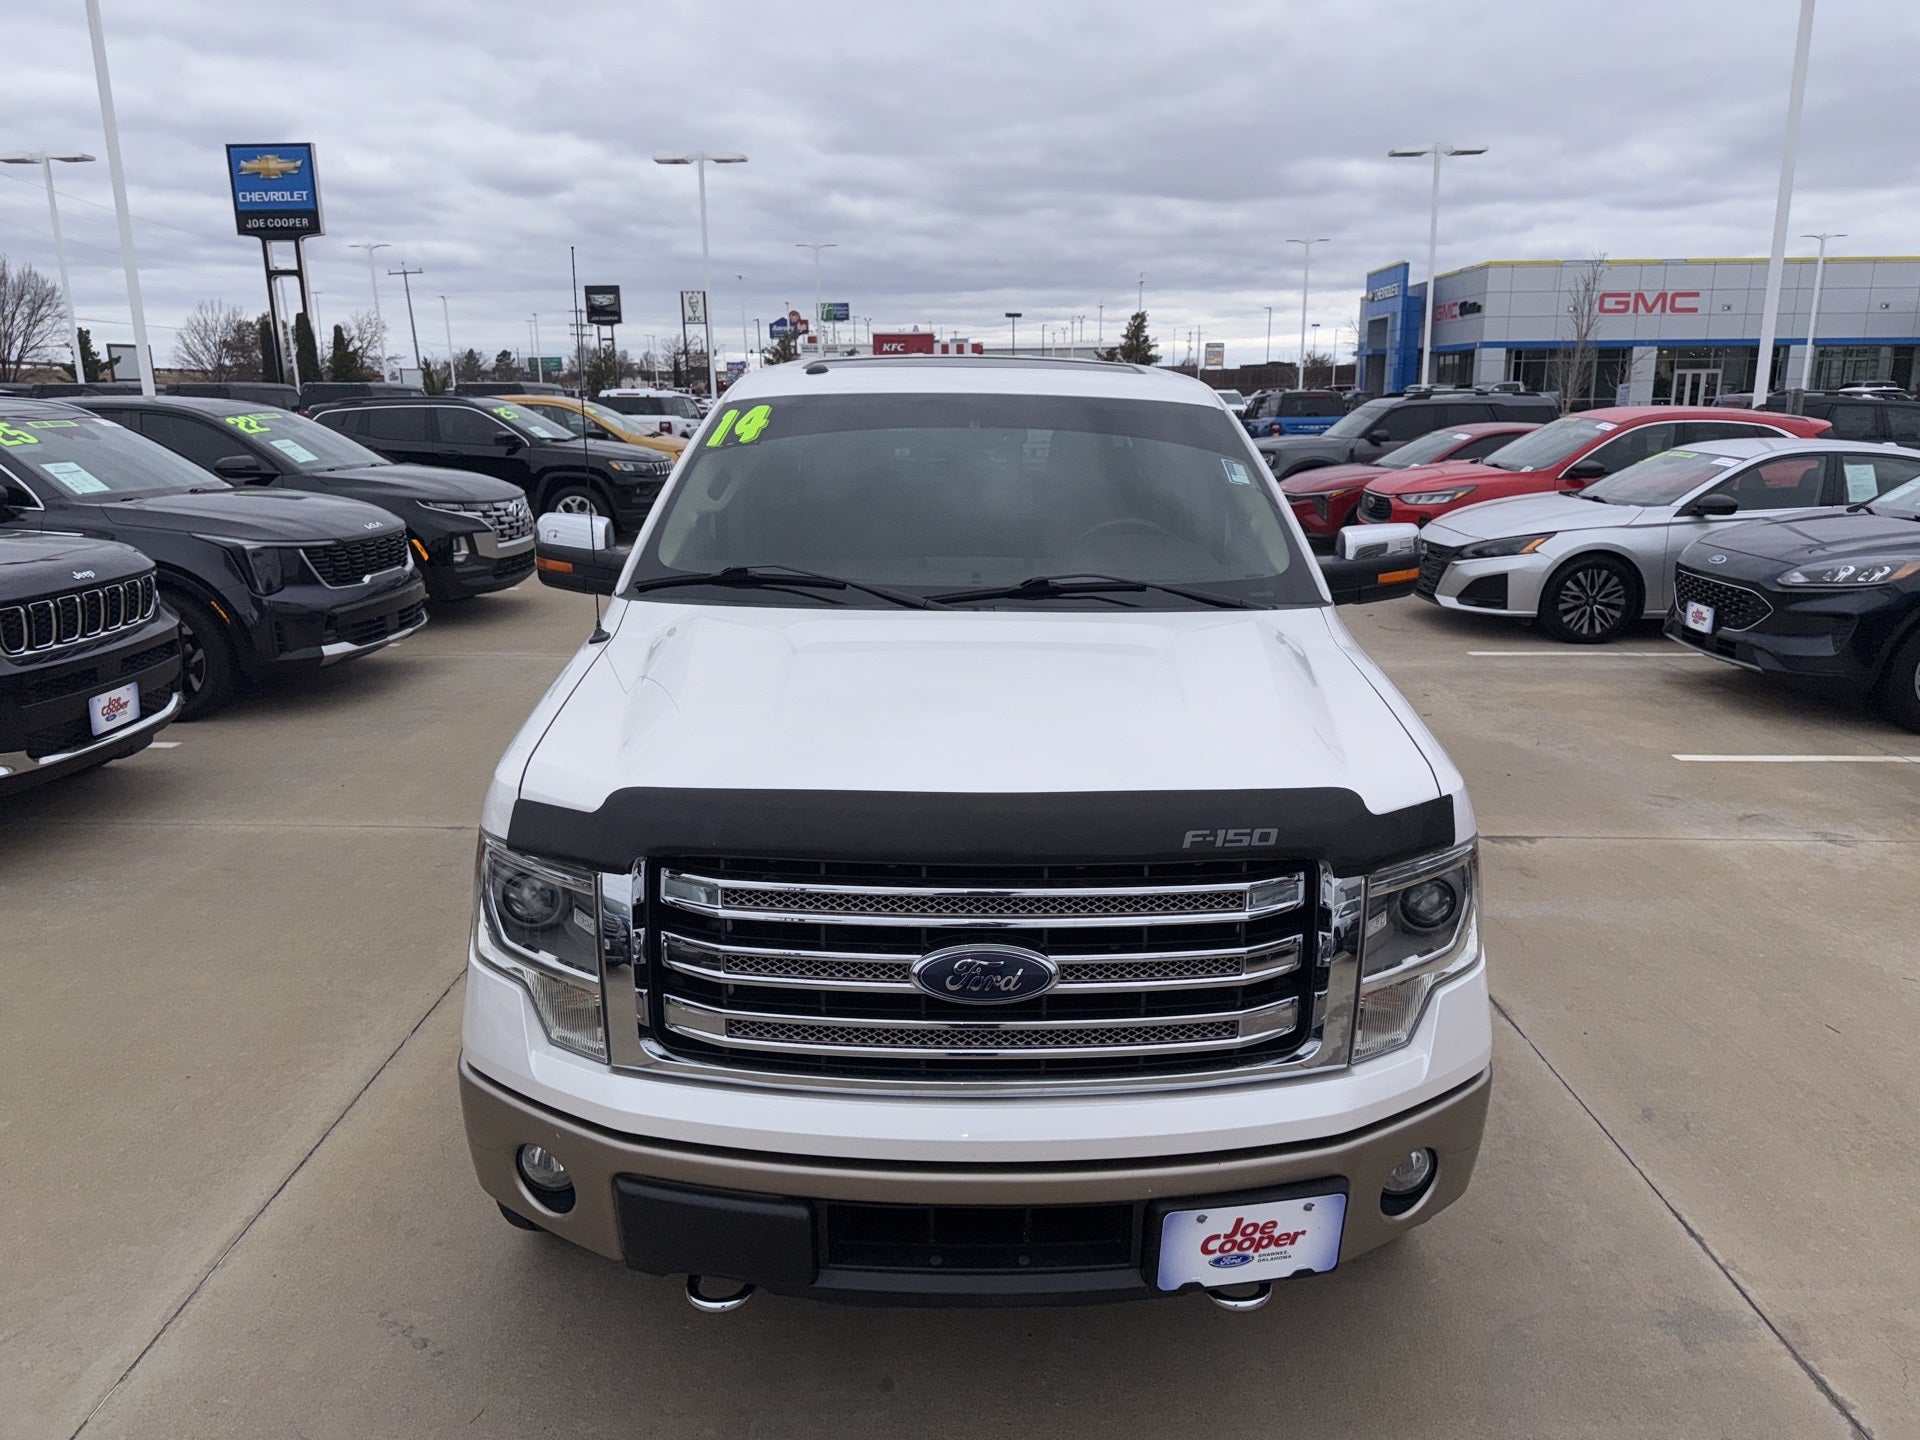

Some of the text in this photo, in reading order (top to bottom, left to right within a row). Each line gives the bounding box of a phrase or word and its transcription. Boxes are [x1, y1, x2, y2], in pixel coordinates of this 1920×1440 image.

[238, 190, 308, 202] CHEVROLET
[246, 217, 309, 228] JOE COOPER
[1598, 291, 1700, 314] GMC
[882, 343, 905, 352] KFC
[225, 415, 271, 434] 22
[706, 404, 772, 447] 14
[72, 570, 95, 580] Jeep
[101, 699, 130, 717] Cooper
[106, 696, 121, 709] Joe
[1182, 828, 1279, 849] F-150
[945, 958, 1025, 991] Ford
[1223, 1217, 1279, 1239] Joe
[1200, 1230, 1307, 1255] Cooper
[1219, 1255, 1243, 1265] Ford
[1257, 1255, 1292, 1263] OKLAHOMA
